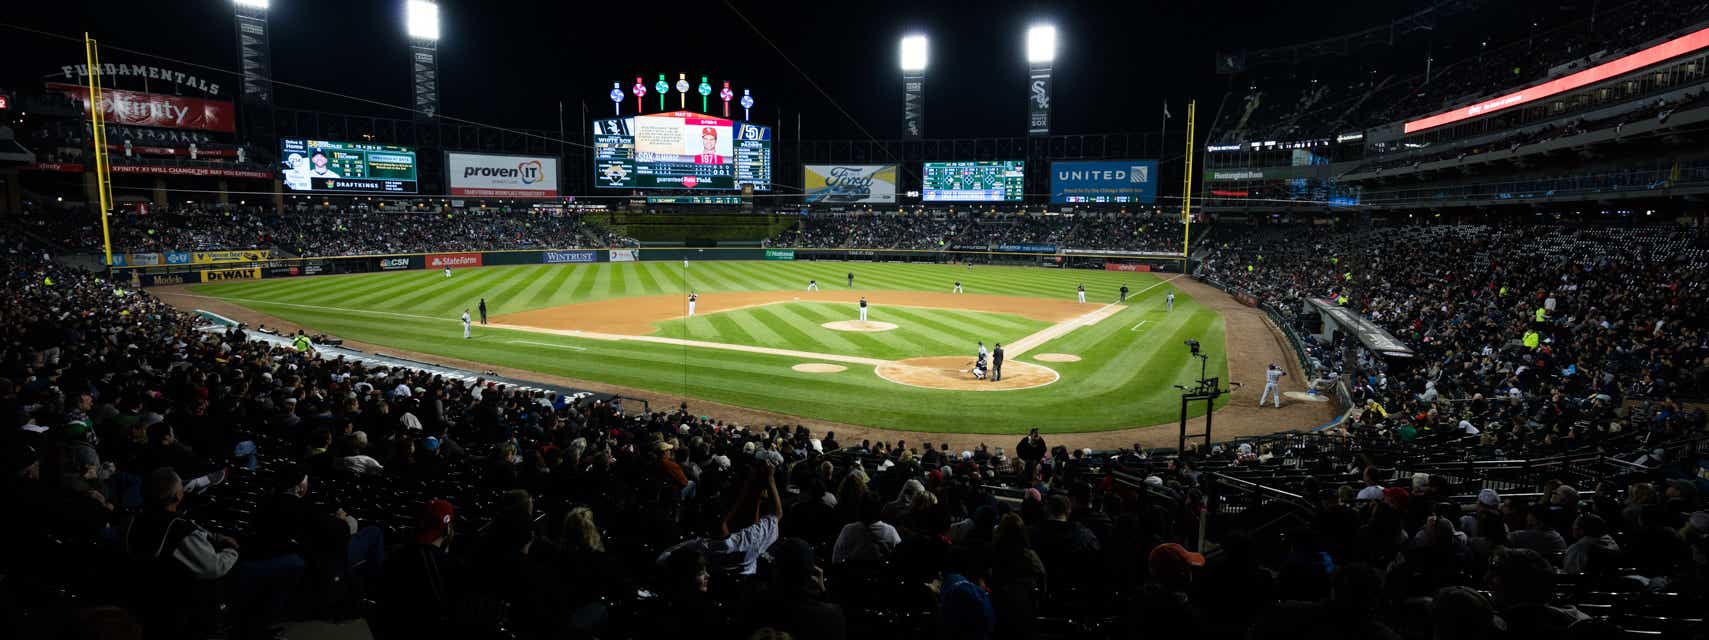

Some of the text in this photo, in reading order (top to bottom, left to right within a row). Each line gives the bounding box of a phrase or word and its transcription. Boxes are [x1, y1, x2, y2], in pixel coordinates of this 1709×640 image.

[61, 64, 220, 95] FUNDAMENTALS
[700, 154, 718, 164] 1971
[463, 166, 537, 178] proven IT
[825, 167, 874, 187] Ford
[1058, 170, 1126, 180] UNITED
[336, 181, 379, 189] DRAFTKINGS
[547, 252, 593, 261] WINTRUST
[391, 258, 409, 266] CSN
[153, 275, 183, 285] Modelo
